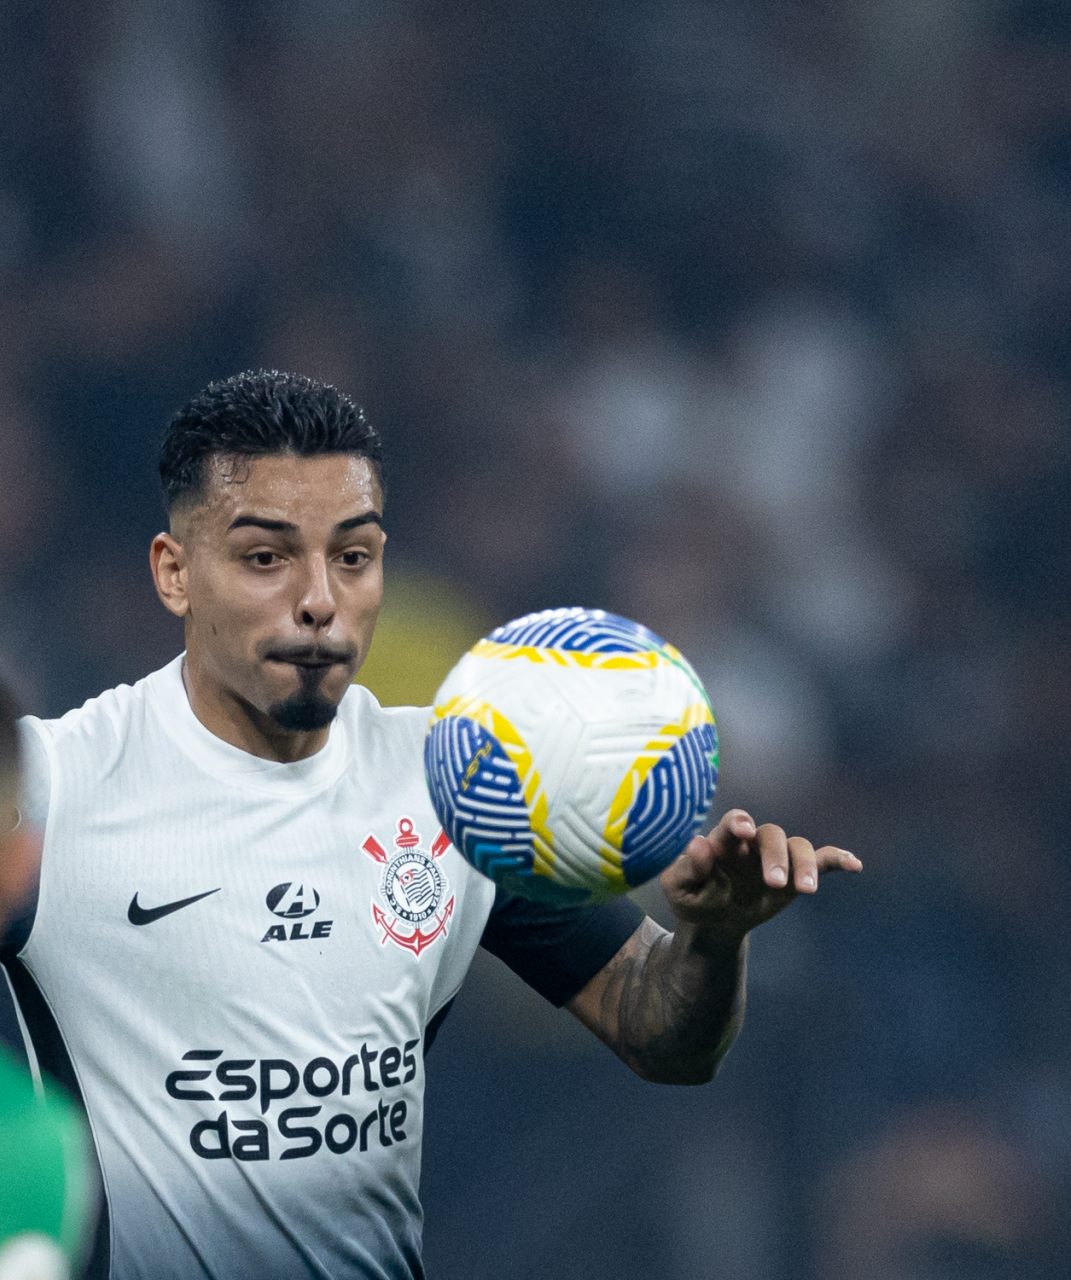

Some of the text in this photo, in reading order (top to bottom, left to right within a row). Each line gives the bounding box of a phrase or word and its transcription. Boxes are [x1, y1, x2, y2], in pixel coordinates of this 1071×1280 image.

[386, 854, 426, 896] CORINTHIANS
[426, 861, 441, 908] PAULISTA
[260, 920, 333, 943] ALE
[408, 912, 427, 922] 1910
[165, 1038, 420, 1116] Esportes
